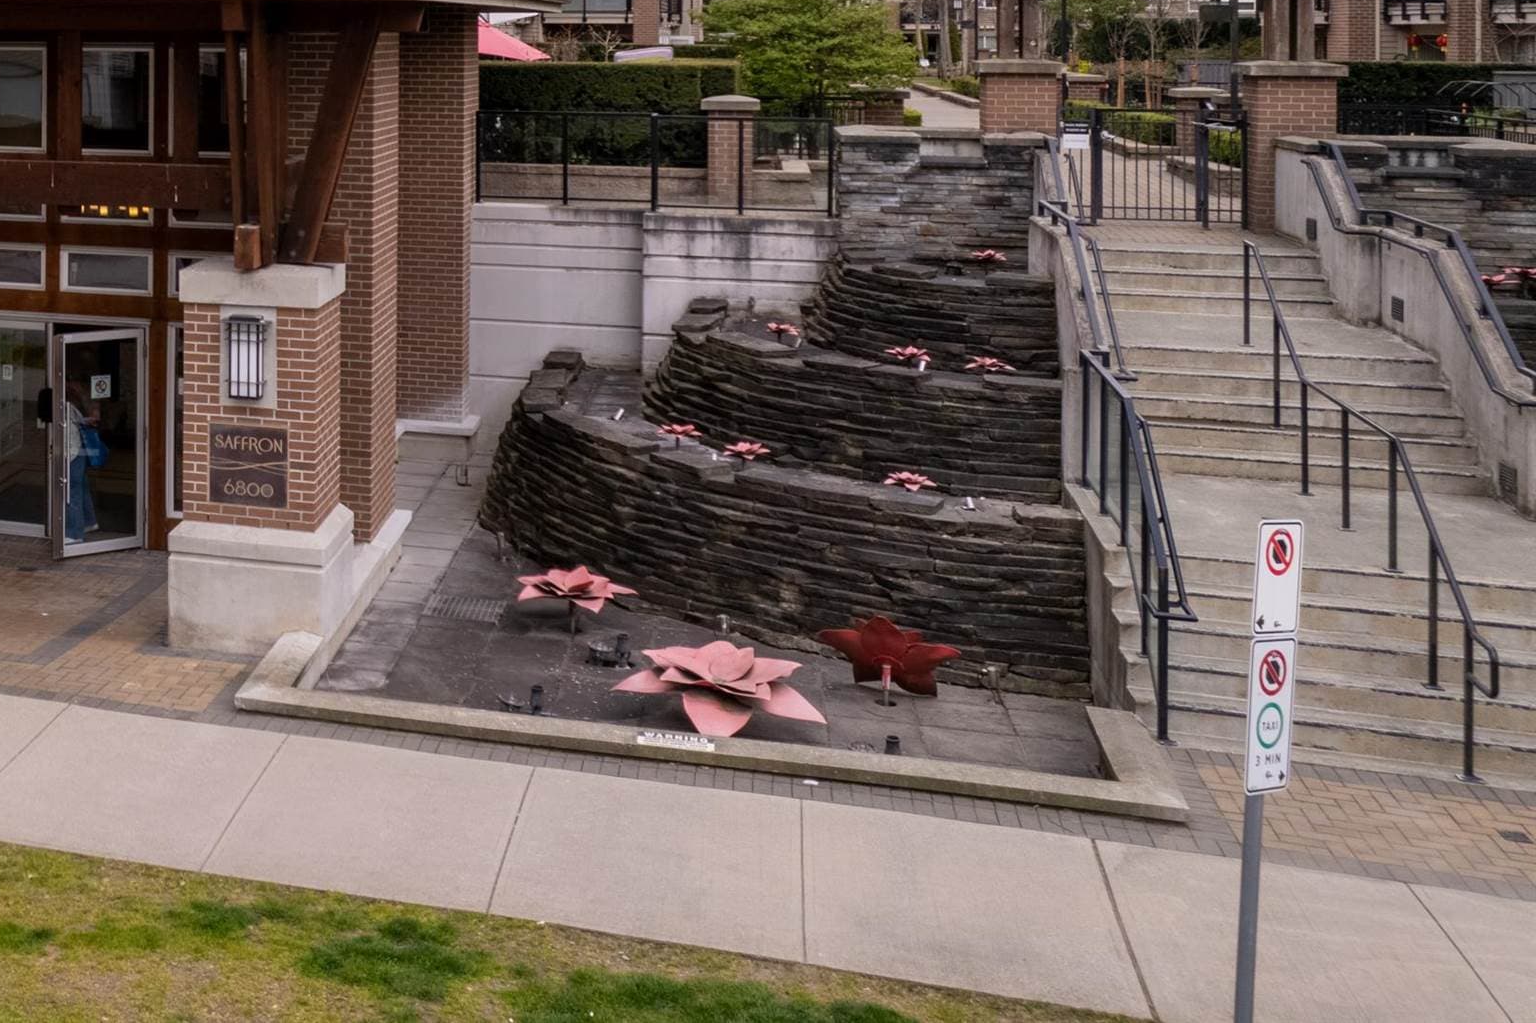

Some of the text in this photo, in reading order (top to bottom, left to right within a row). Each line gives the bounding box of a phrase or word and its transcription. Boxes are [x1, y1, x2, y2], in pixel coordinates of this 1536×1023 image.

[215, 434, 283, 455] SAFFRON
[224, 478, 274, 498] 6800
[1262, 721, 1279, 730] TAXI
[645, 732, 708, 744] WARNING
[1264, 753, 1281, 765] MIN
